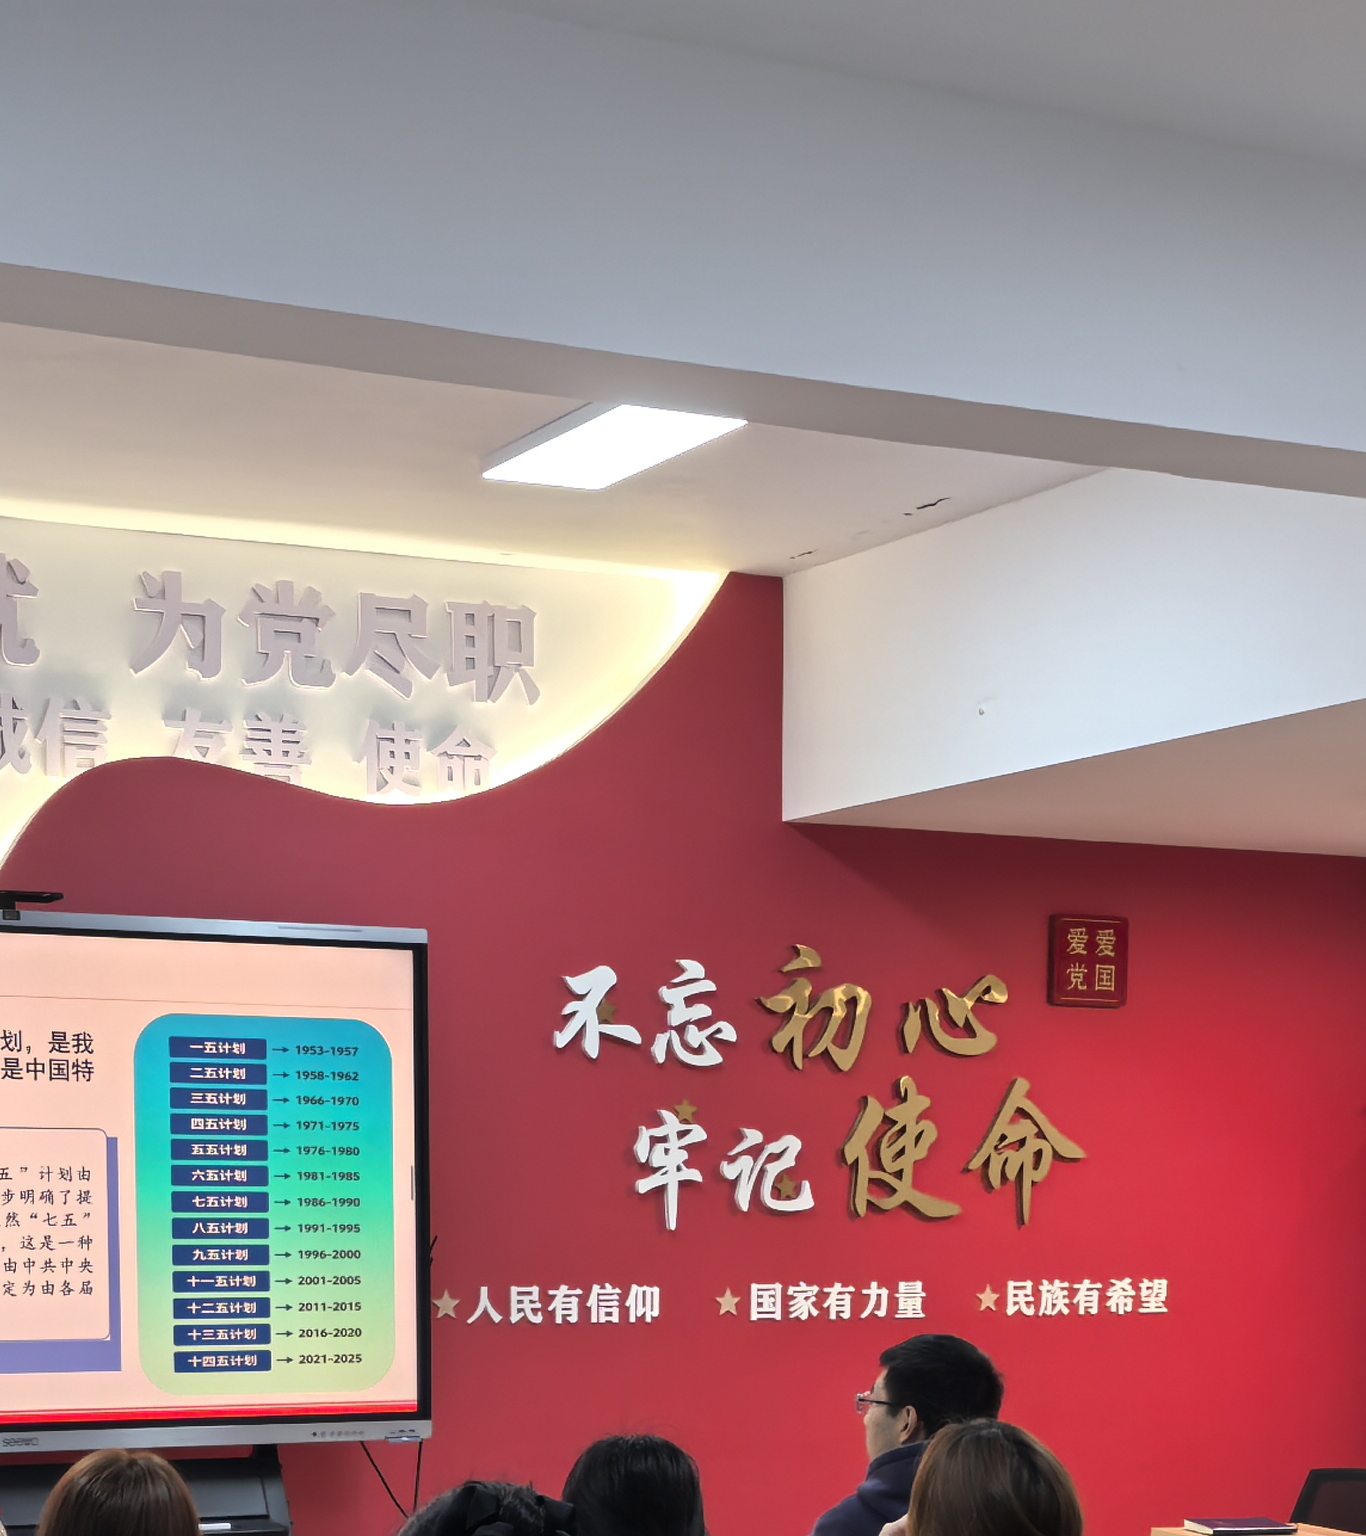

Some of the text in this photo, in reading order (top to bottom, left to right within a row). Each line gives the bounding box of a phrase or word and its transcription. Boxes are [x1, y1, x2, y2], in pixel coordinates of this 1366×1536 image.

[130, 570, 542, 706] 为党尽职
[163, 708, 313, 787] 友善
[354, 718, 499, 796] 使命
[189, 1041, 359, 1057] 一五计划 1953-1957
[189, 1067, 360, 1082] 二五计划 1958-1962
[189, 1093, 360, 1107] 三五计划 1966-1970
[190, 1118, 360, 1132] 四五计划 1971-1975
[190, 1144, 360, 1157] 五五计划 1976-1980
[190, 1169, 361, 1183] 六五计划 1981-1985
[191, 1196, 361, 1209] 七五计划 1986-1990
[191, 1222, 361, 1235] 八五计划 1991-1995
[192, 1248, 362, 1262] 九五计划 1996-2000
[186, 1274, 362, 1289] 十一五计划 2001-2005
[466, 1283, 661, 1324] 人民有信仰
[749, 1281, 927, 1320] 国家有力量
[1004, 1278, 1169, 1317] 民族有希望
[186, 1301, 362, 1315] 十二五计划 2011-2015
[187, 1327, 362, 1341] 十三五计划 2016-2020
[187, 1353, 363, 1368] 十四五计划 2021-2025
